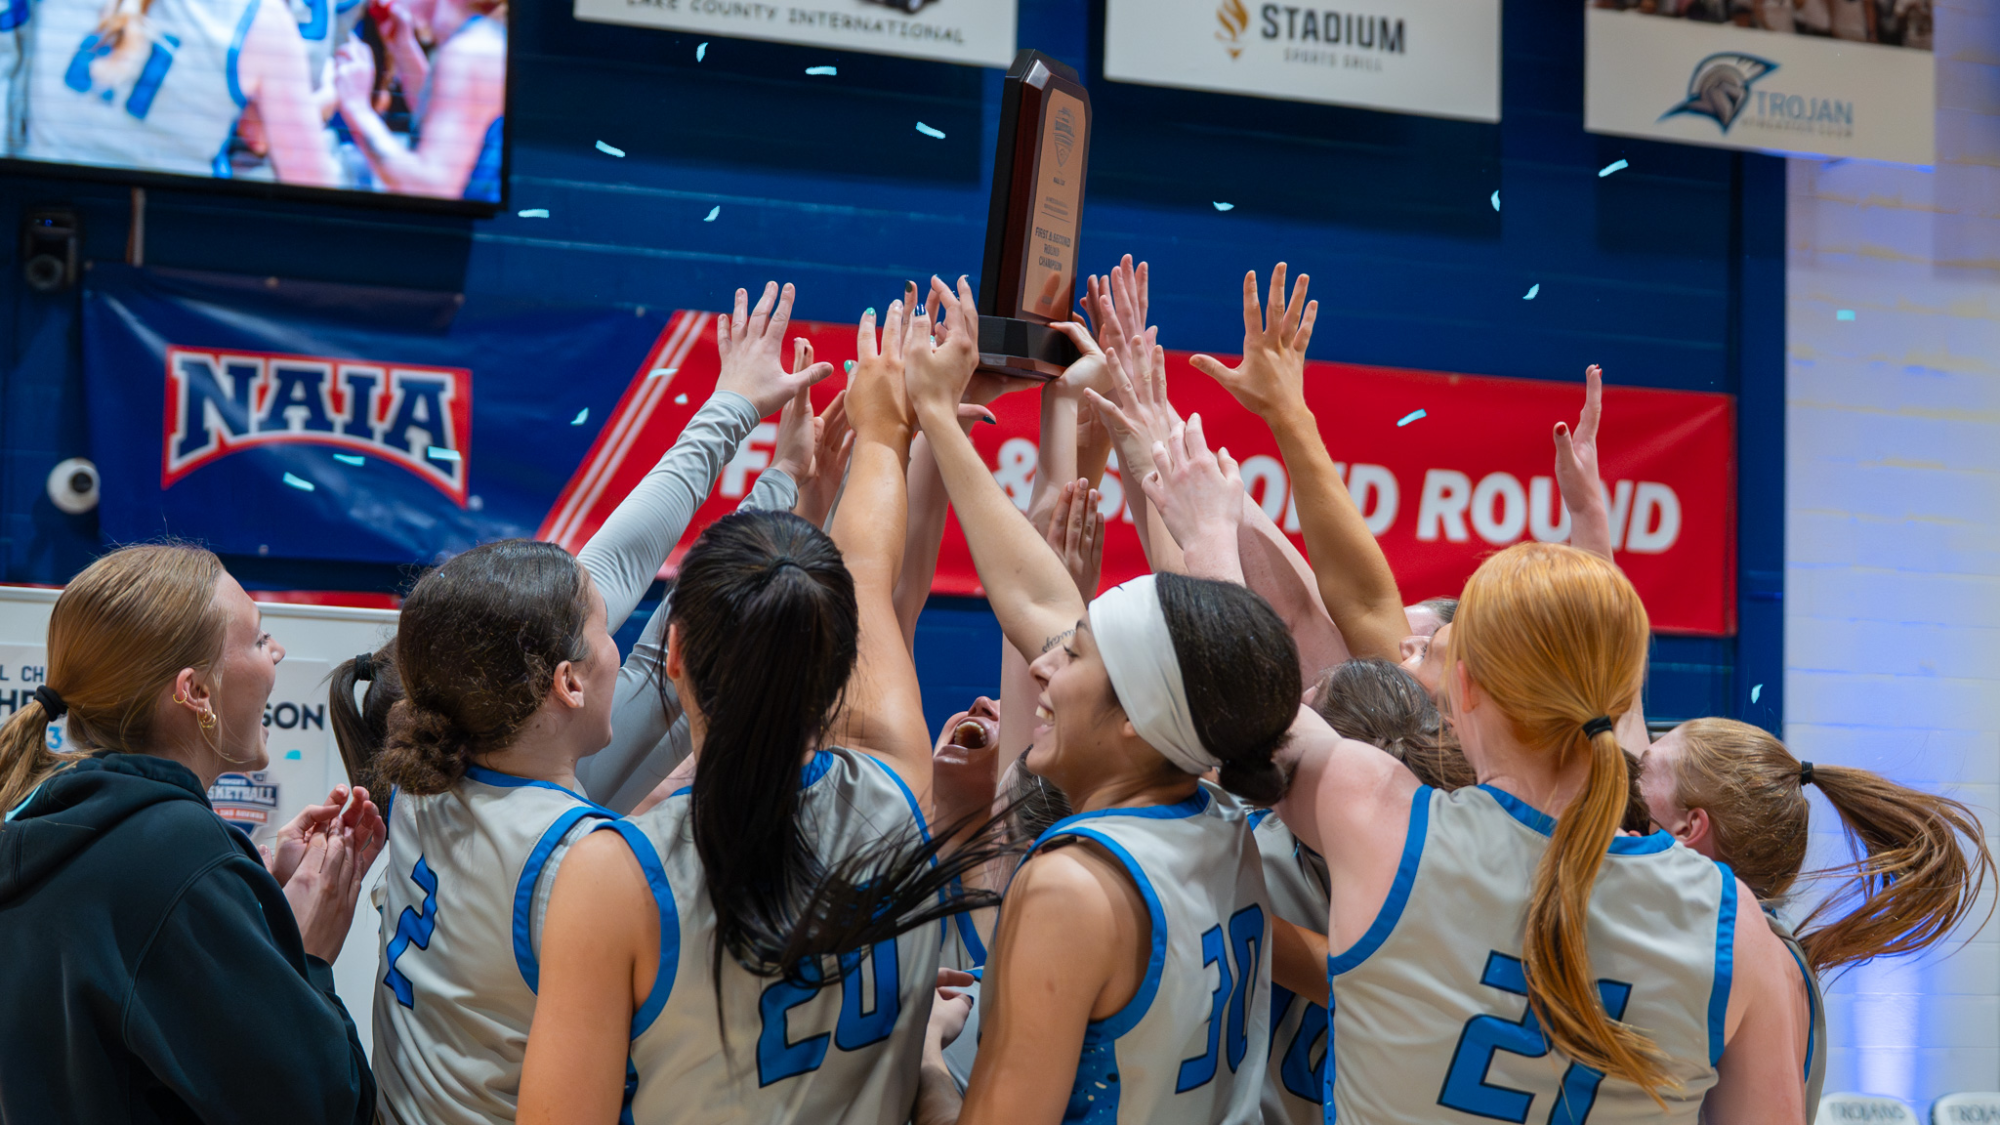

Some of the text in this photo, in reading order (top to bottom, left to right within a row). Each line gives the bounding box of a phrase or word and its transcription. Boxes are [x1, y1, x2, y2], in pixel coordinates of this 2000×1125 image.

[689, 0, 780, 20] COUNTY
[788, 8, 966, 44] INTERNATIONAL
[1261, 4, 1405, 55] STADIUM
[1753, 90, 1854, 125] TROJAN
[1035, 227, 1048, 240] FIRST
[168, 350, 460, 494] NAIA
[994, 438, 1038, 508] &
[1416, 468, 1682, 552] ROUND
[756, 872, 902, 1089] 20
[1174, 902, 1267, 1095] 30
[1436, 948, 1634, 1125] 21
